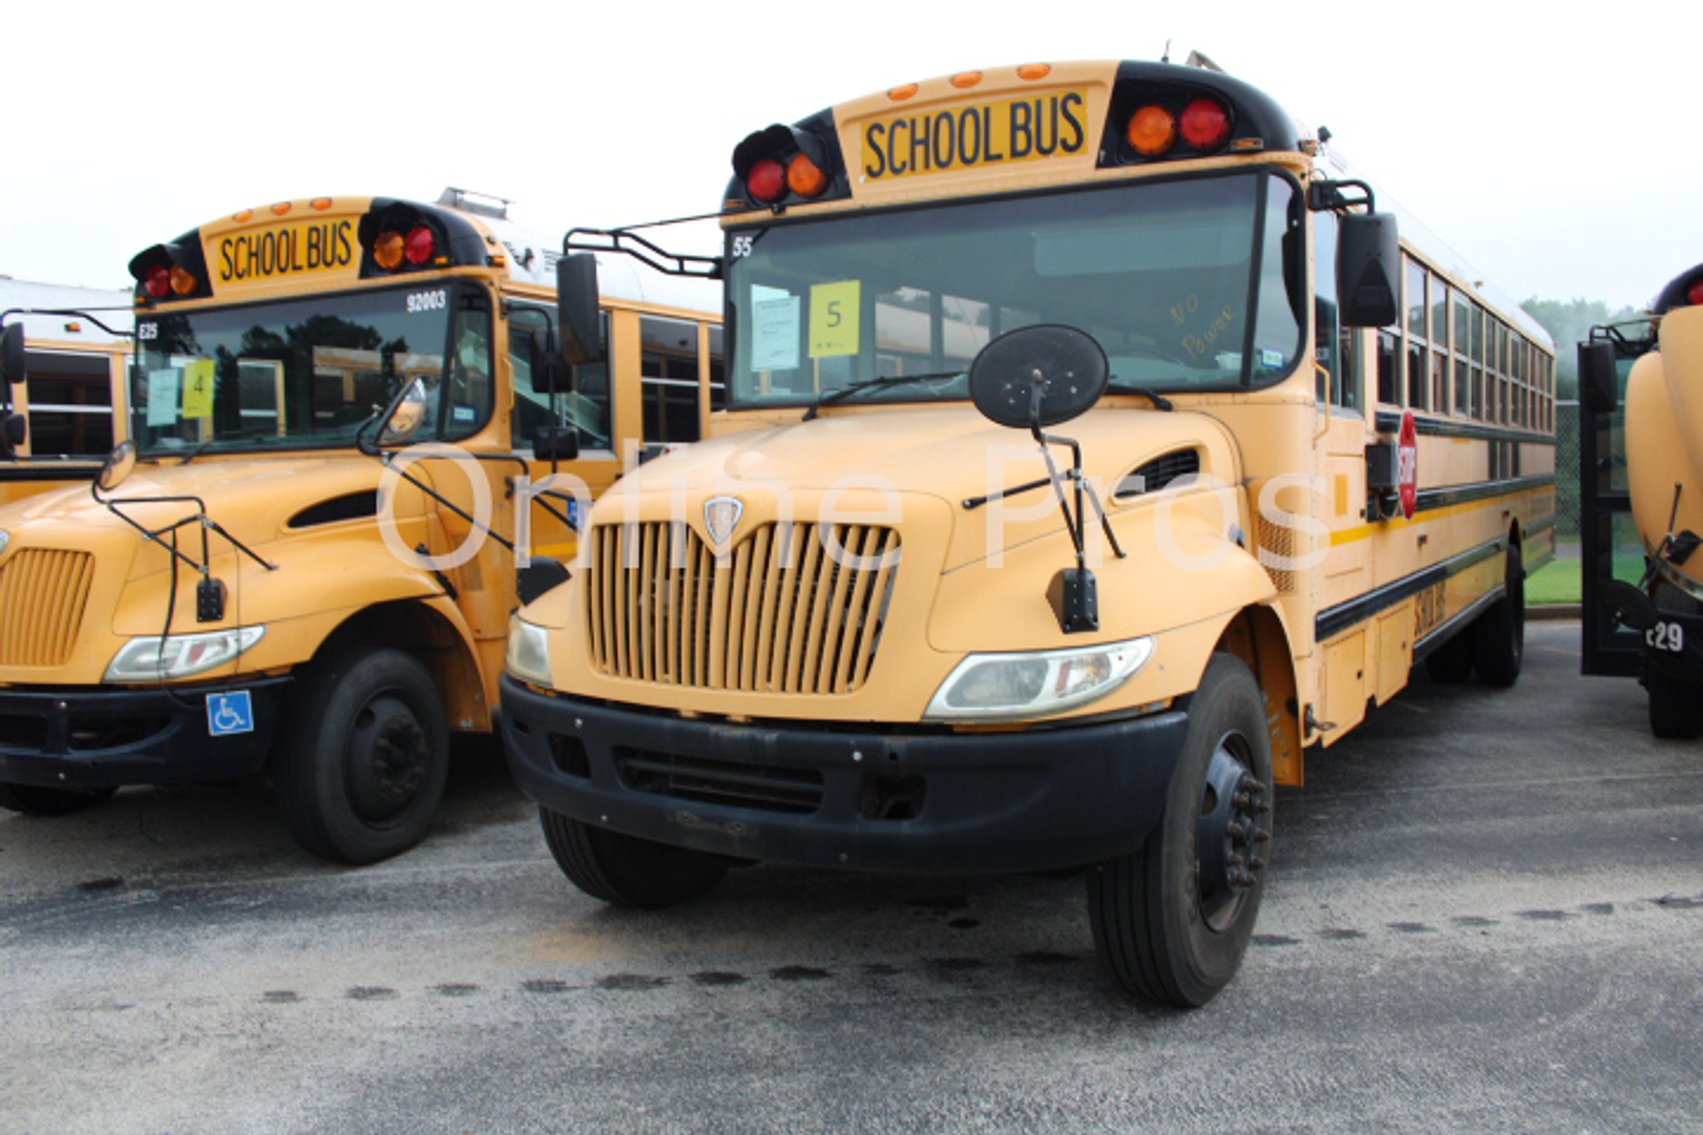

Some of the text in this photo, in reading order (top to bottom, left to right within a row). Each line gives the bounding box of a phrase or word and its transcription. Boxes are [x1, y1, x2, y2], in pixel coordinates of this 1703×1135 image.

[865, 92, 1085, 178] SCHOOL BUS
[221, 220, 352, 281] SCHOOL BUS
[732, 236, 753, 257] 55
[406, 289, 446, 313] 92003
[827, 300, 842, 328] 5
[193, 374, 205, 394] 4
